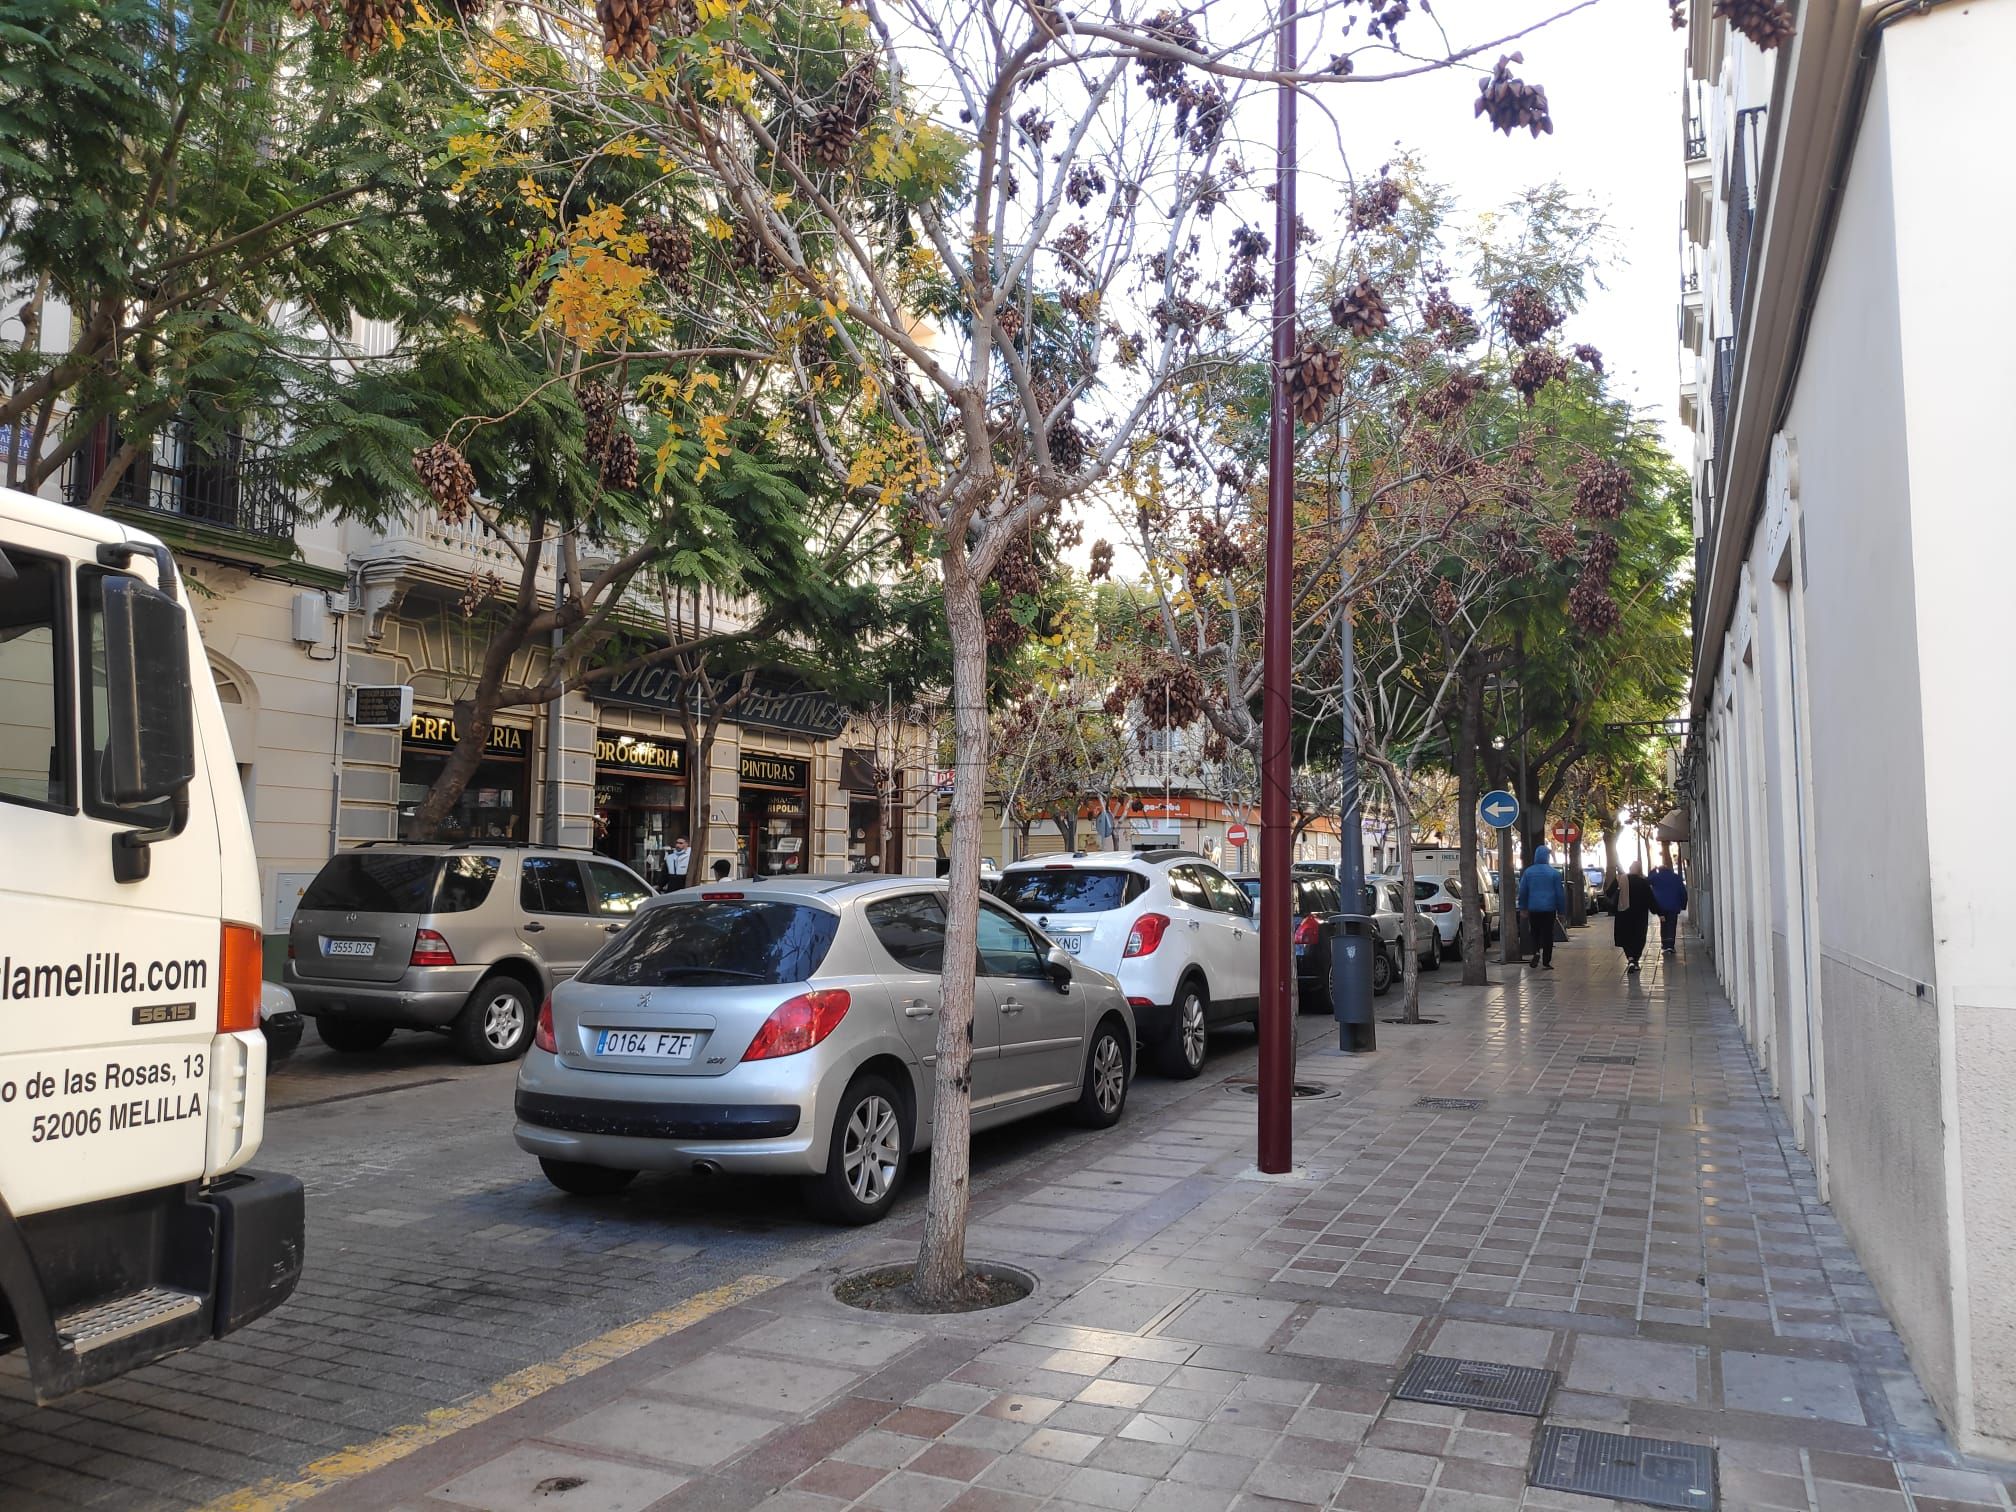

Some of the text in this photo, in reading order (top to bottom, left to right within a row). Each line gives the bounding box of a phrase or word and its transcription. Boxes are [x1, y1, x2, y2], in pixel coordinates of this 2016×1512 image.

[596, 741, 679, 768] DROGUERIA
[742, 759, 795, 781] PINTURAS
[332, 942, 373, 954] 3555 DZS
[0, 952, 208, 1000] lamelilla.com
[139, 1005, 190, 1024] 56.15
[607, 1033, 692, 1056] 0164 FZF
[0, 1053, 205, 1103] o de las Rosas, 13
[32, 1092, 202, 1143] 52006 MELILLA
